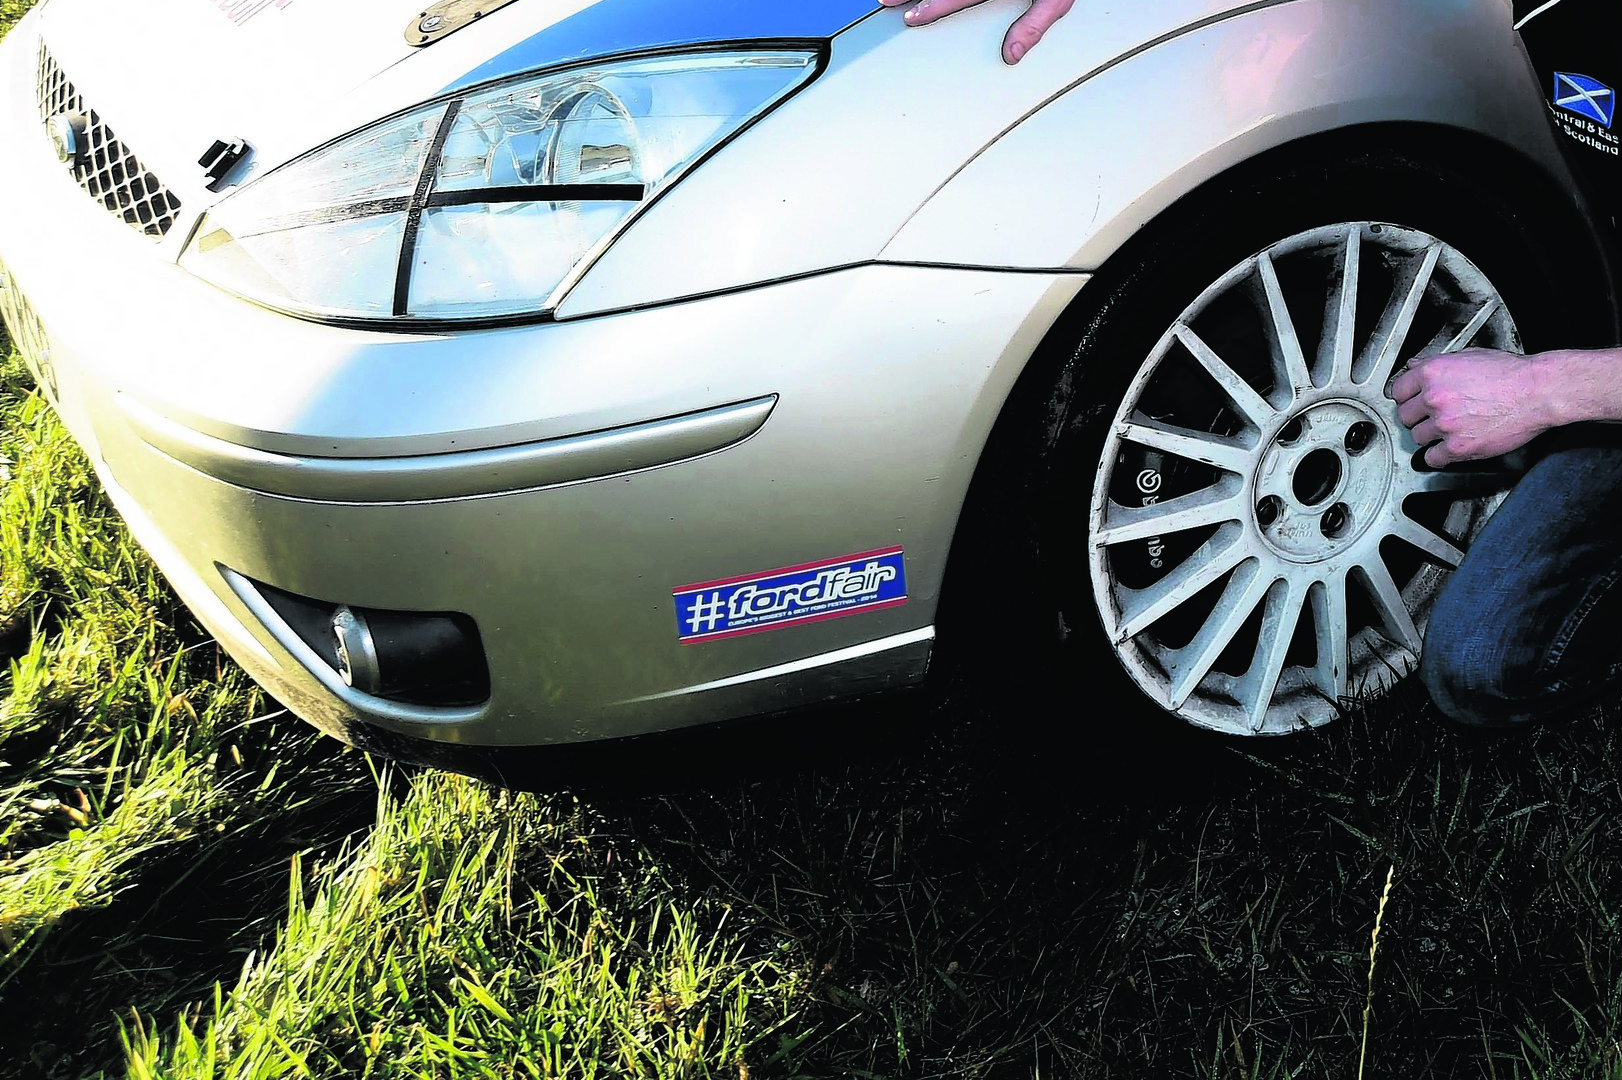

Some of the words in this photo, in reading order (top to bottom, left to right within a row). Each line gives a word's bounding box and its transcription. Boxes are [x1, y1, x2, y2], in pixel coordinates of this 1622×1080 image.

[1587, 122, 1596, 133] &
[1141, 495, 1165, 569] bmbo
[685, 561, 896, 633] #fordfair
[827, 598, 856, 608] FESTIVAL
